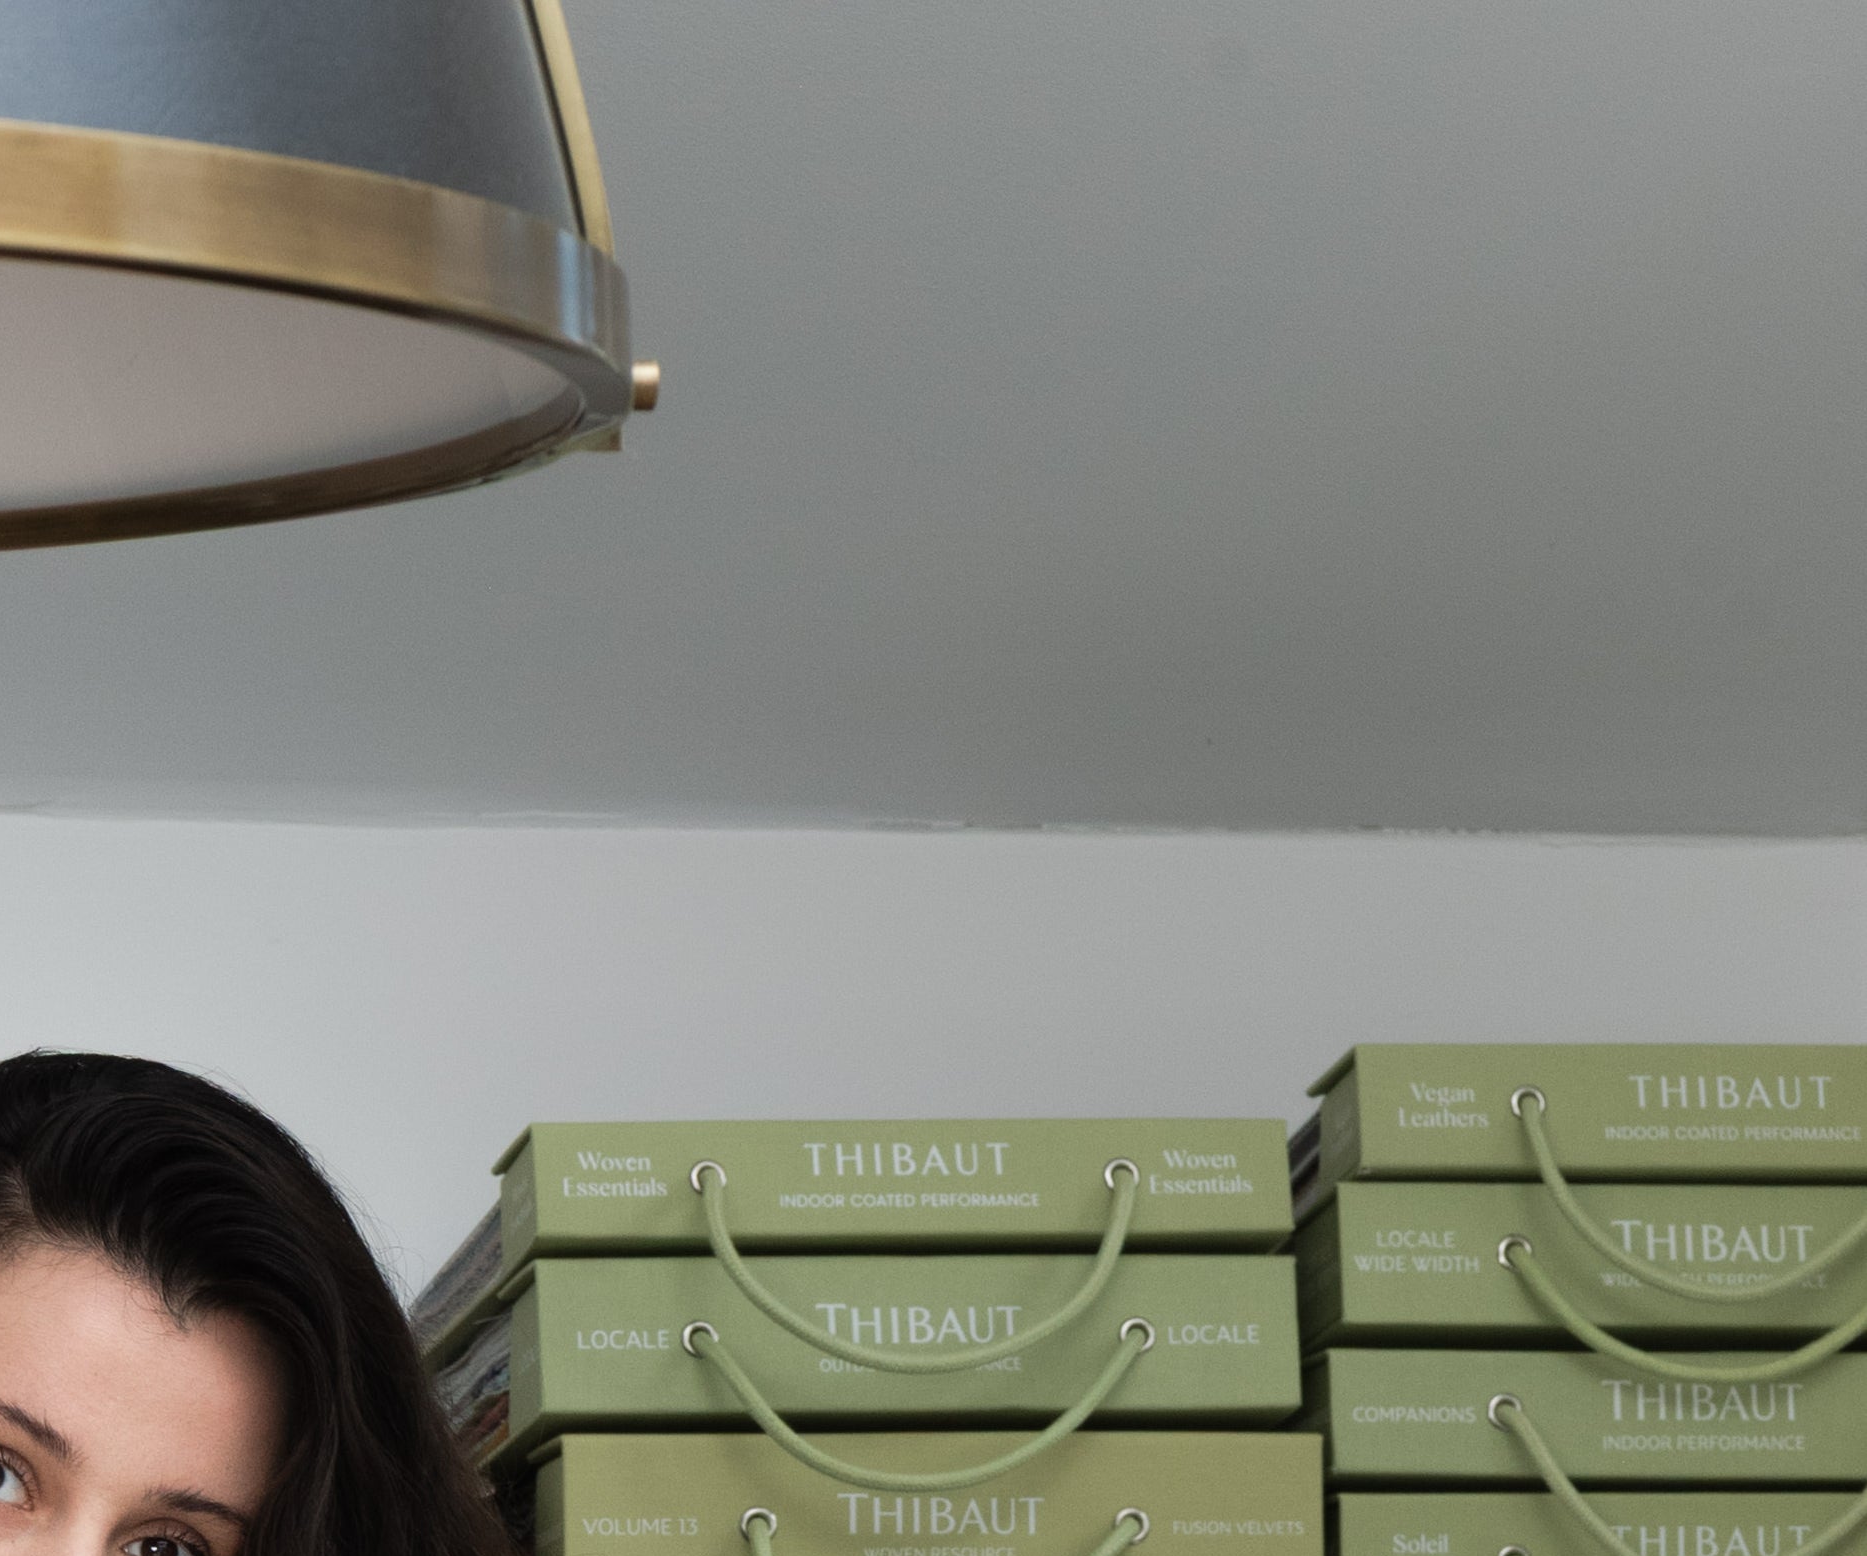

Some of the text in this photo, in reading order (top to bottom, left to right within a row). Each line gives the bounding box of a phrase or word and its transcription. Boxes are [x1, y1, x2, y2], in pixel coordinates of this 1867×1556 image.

[1411, 1083, 1475, 1107] Vegan
[1629, 1075, 1833, 1110] THIBAUT
[1398, 1107, 1489, 1129] Leathers
[1605, 1126, 1861, 1142] INDOOR COATED PERFORMANCE
[577, 1150, 651, 1173] Woven
[804, 1142, 1011, 1177] THIBAUT
[1163, 1149, 1237, 1172] Woven
[562, 1175, 668, 1199] Essentials
[1149, 1173, 1255, 1197] Essentials
[780, 1192, 1040, 1209] INDOOR COATED PERFORMANCE
[1376, 1231, 1455, 1250] LOCALE
[1612, 1220, 1814, 1262] THIBAUT
[1354, 1254, 1480, 1273] WIDE WIDTH
[816, 1303, 1023, 1345] THIBAUT
[1167, 1324, 1260, 1346] LOCALE
[576, 1329, 670, 1351] LOCALE
[1602, 1379, 1804, 1421] THIBAUT
[1352, 1405, 1477, 1424] COMPANIONS
[1603, 1435, 1806, 1450] INDOOR PERFORMANCE
[837, 1493, 1046, 1537] THIBAUT
[582, 1517, 700, 1536] VOLUME 13
[1172, 1520, 1305, 1536] FUSION VELVETS
[1392, 1533, 1450, 1555] Soleil
